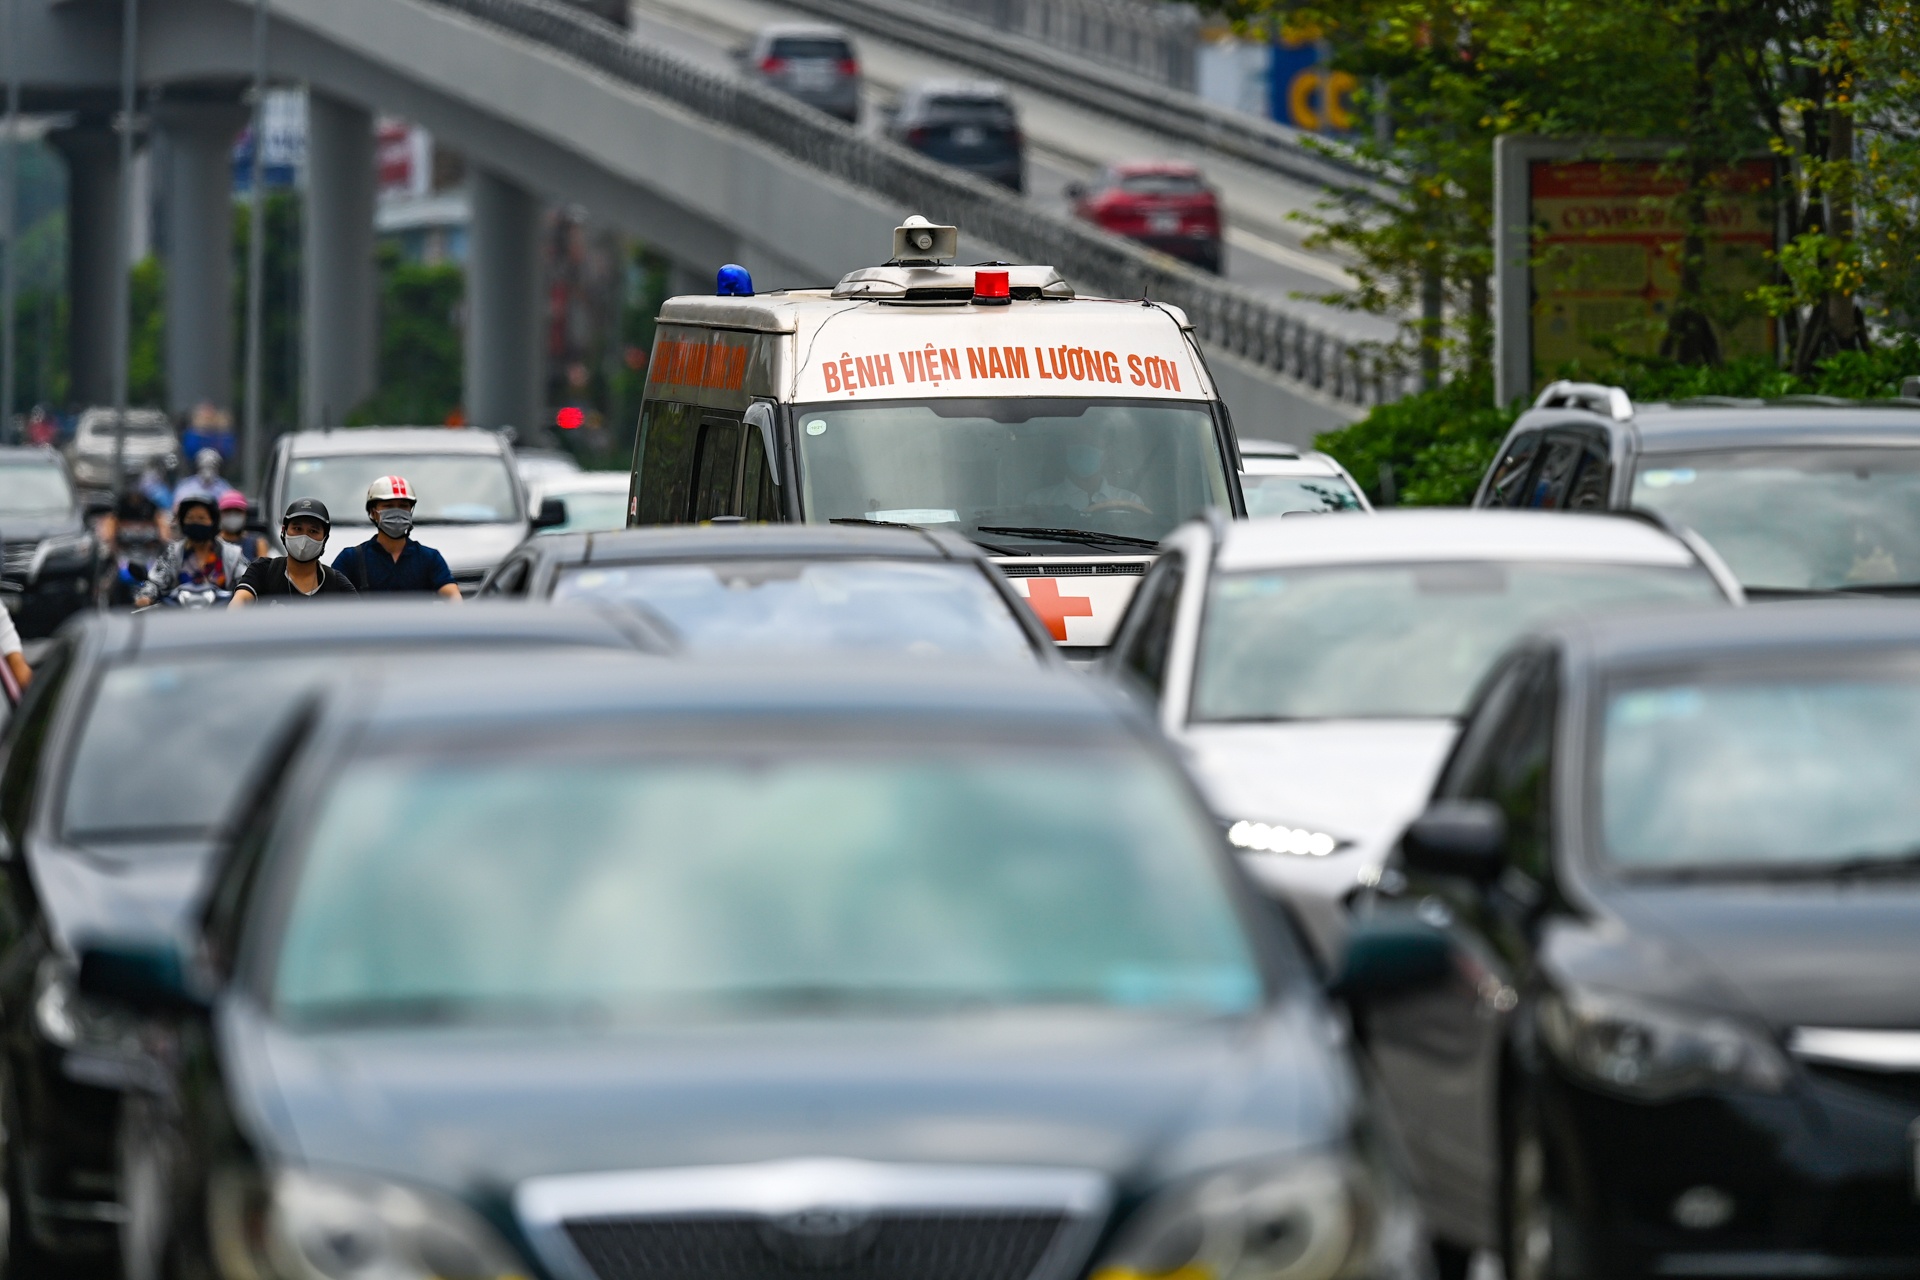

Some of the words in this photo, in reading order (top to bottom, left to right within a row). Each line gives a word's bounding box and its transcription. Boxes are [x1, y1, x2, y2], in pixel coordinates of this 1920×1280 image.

[822, 352, 895, 396] BỆNH
[898, 343, 962, 387] VIỆN
[966, 347, 1030, 379] NAM
[1034, 345, 1122, 384] LƯƠNG
[1127, 354, 1181, 392] SƠN
